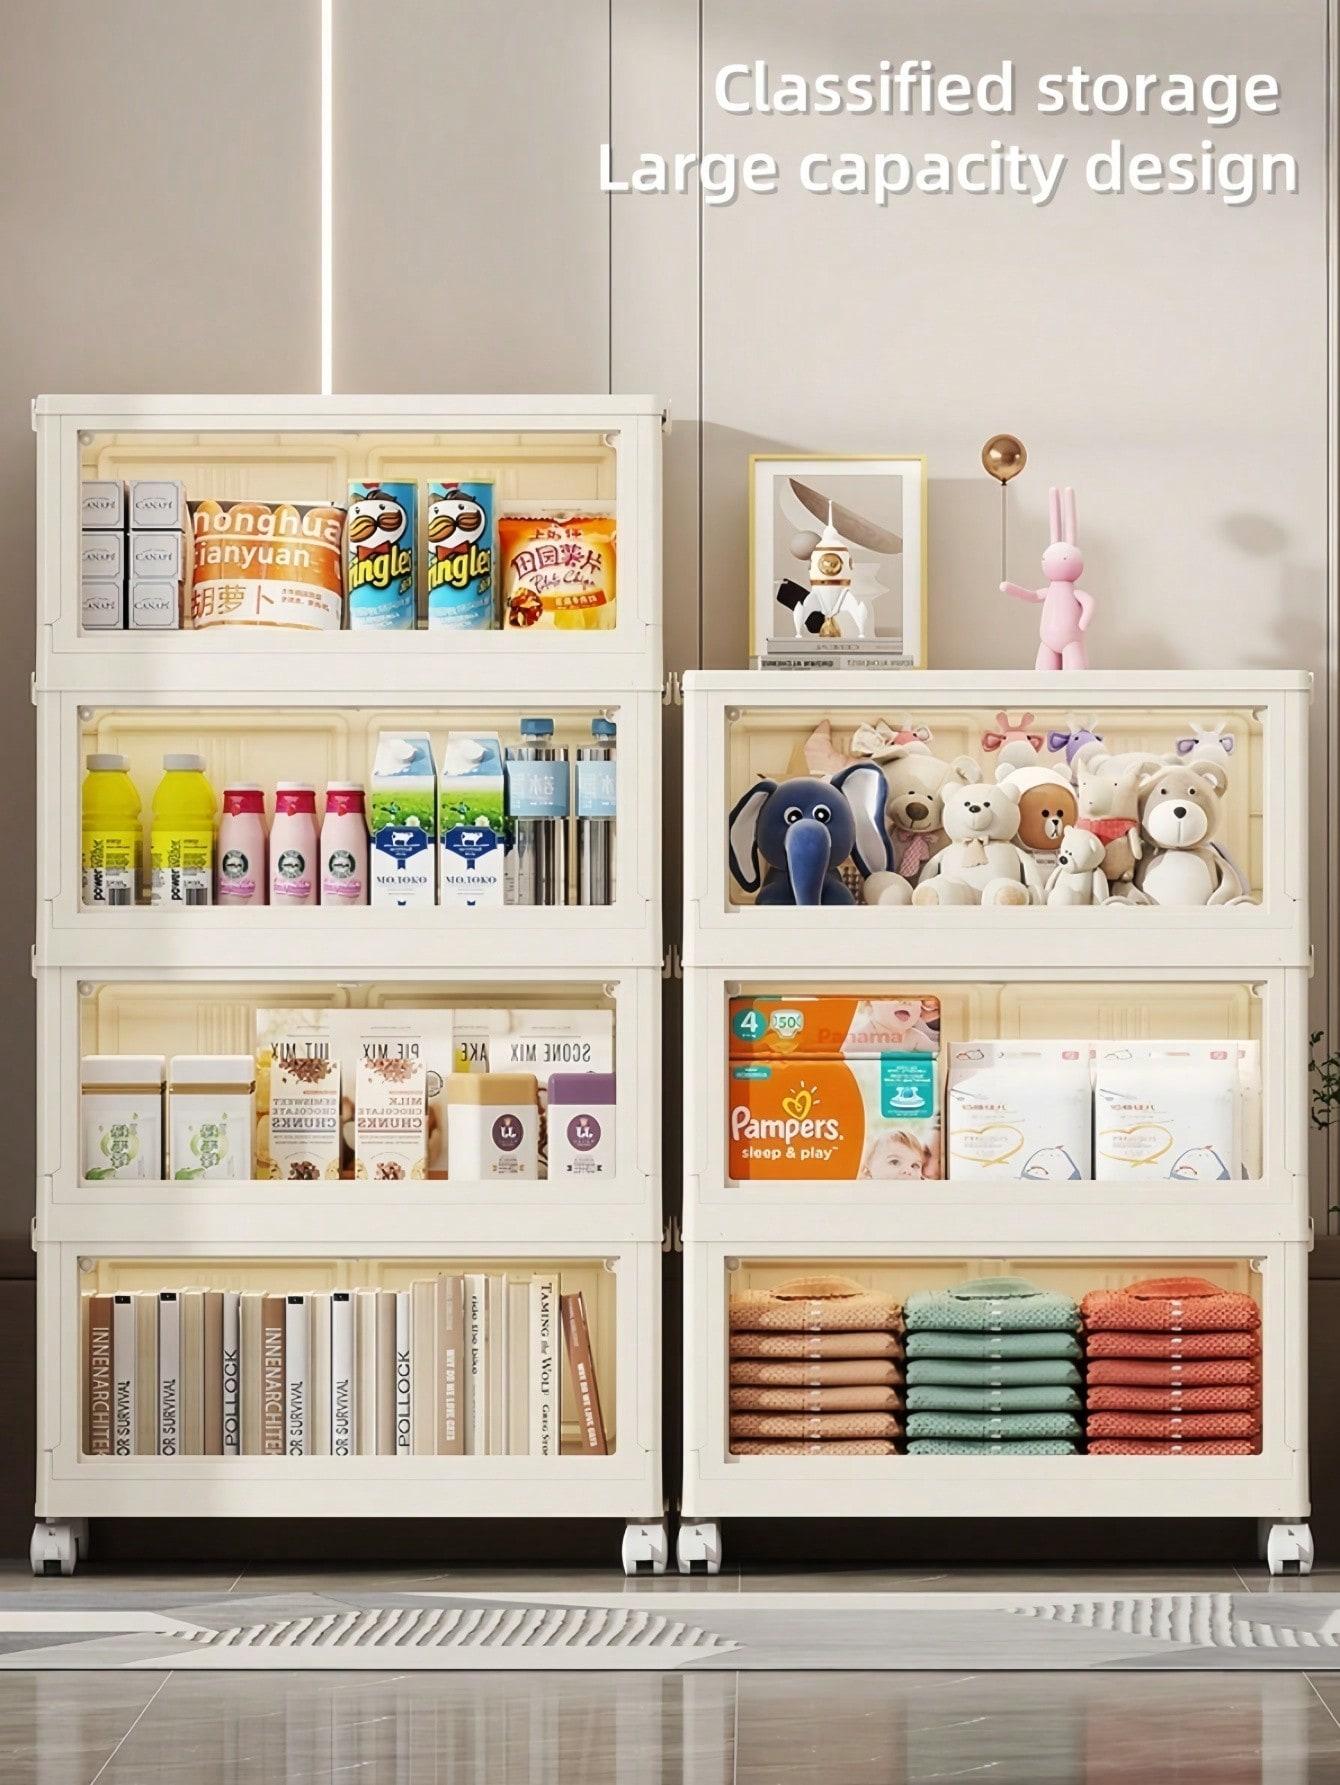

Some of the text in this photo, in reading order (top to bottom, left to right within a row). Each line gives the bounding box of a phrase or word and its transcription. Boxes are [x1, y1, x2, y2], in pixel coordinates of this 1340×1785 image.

[740, 1010, 759, 1033] 4
[741, 1146, 782, 1160] sleep
[785, 1147, 796, 1159] &
[540, 1282, 553, 1337] TAMING
[224, 1349, 239, 1447] POLLOCK
[397, 1350, 411, 1447] POLLOCK
